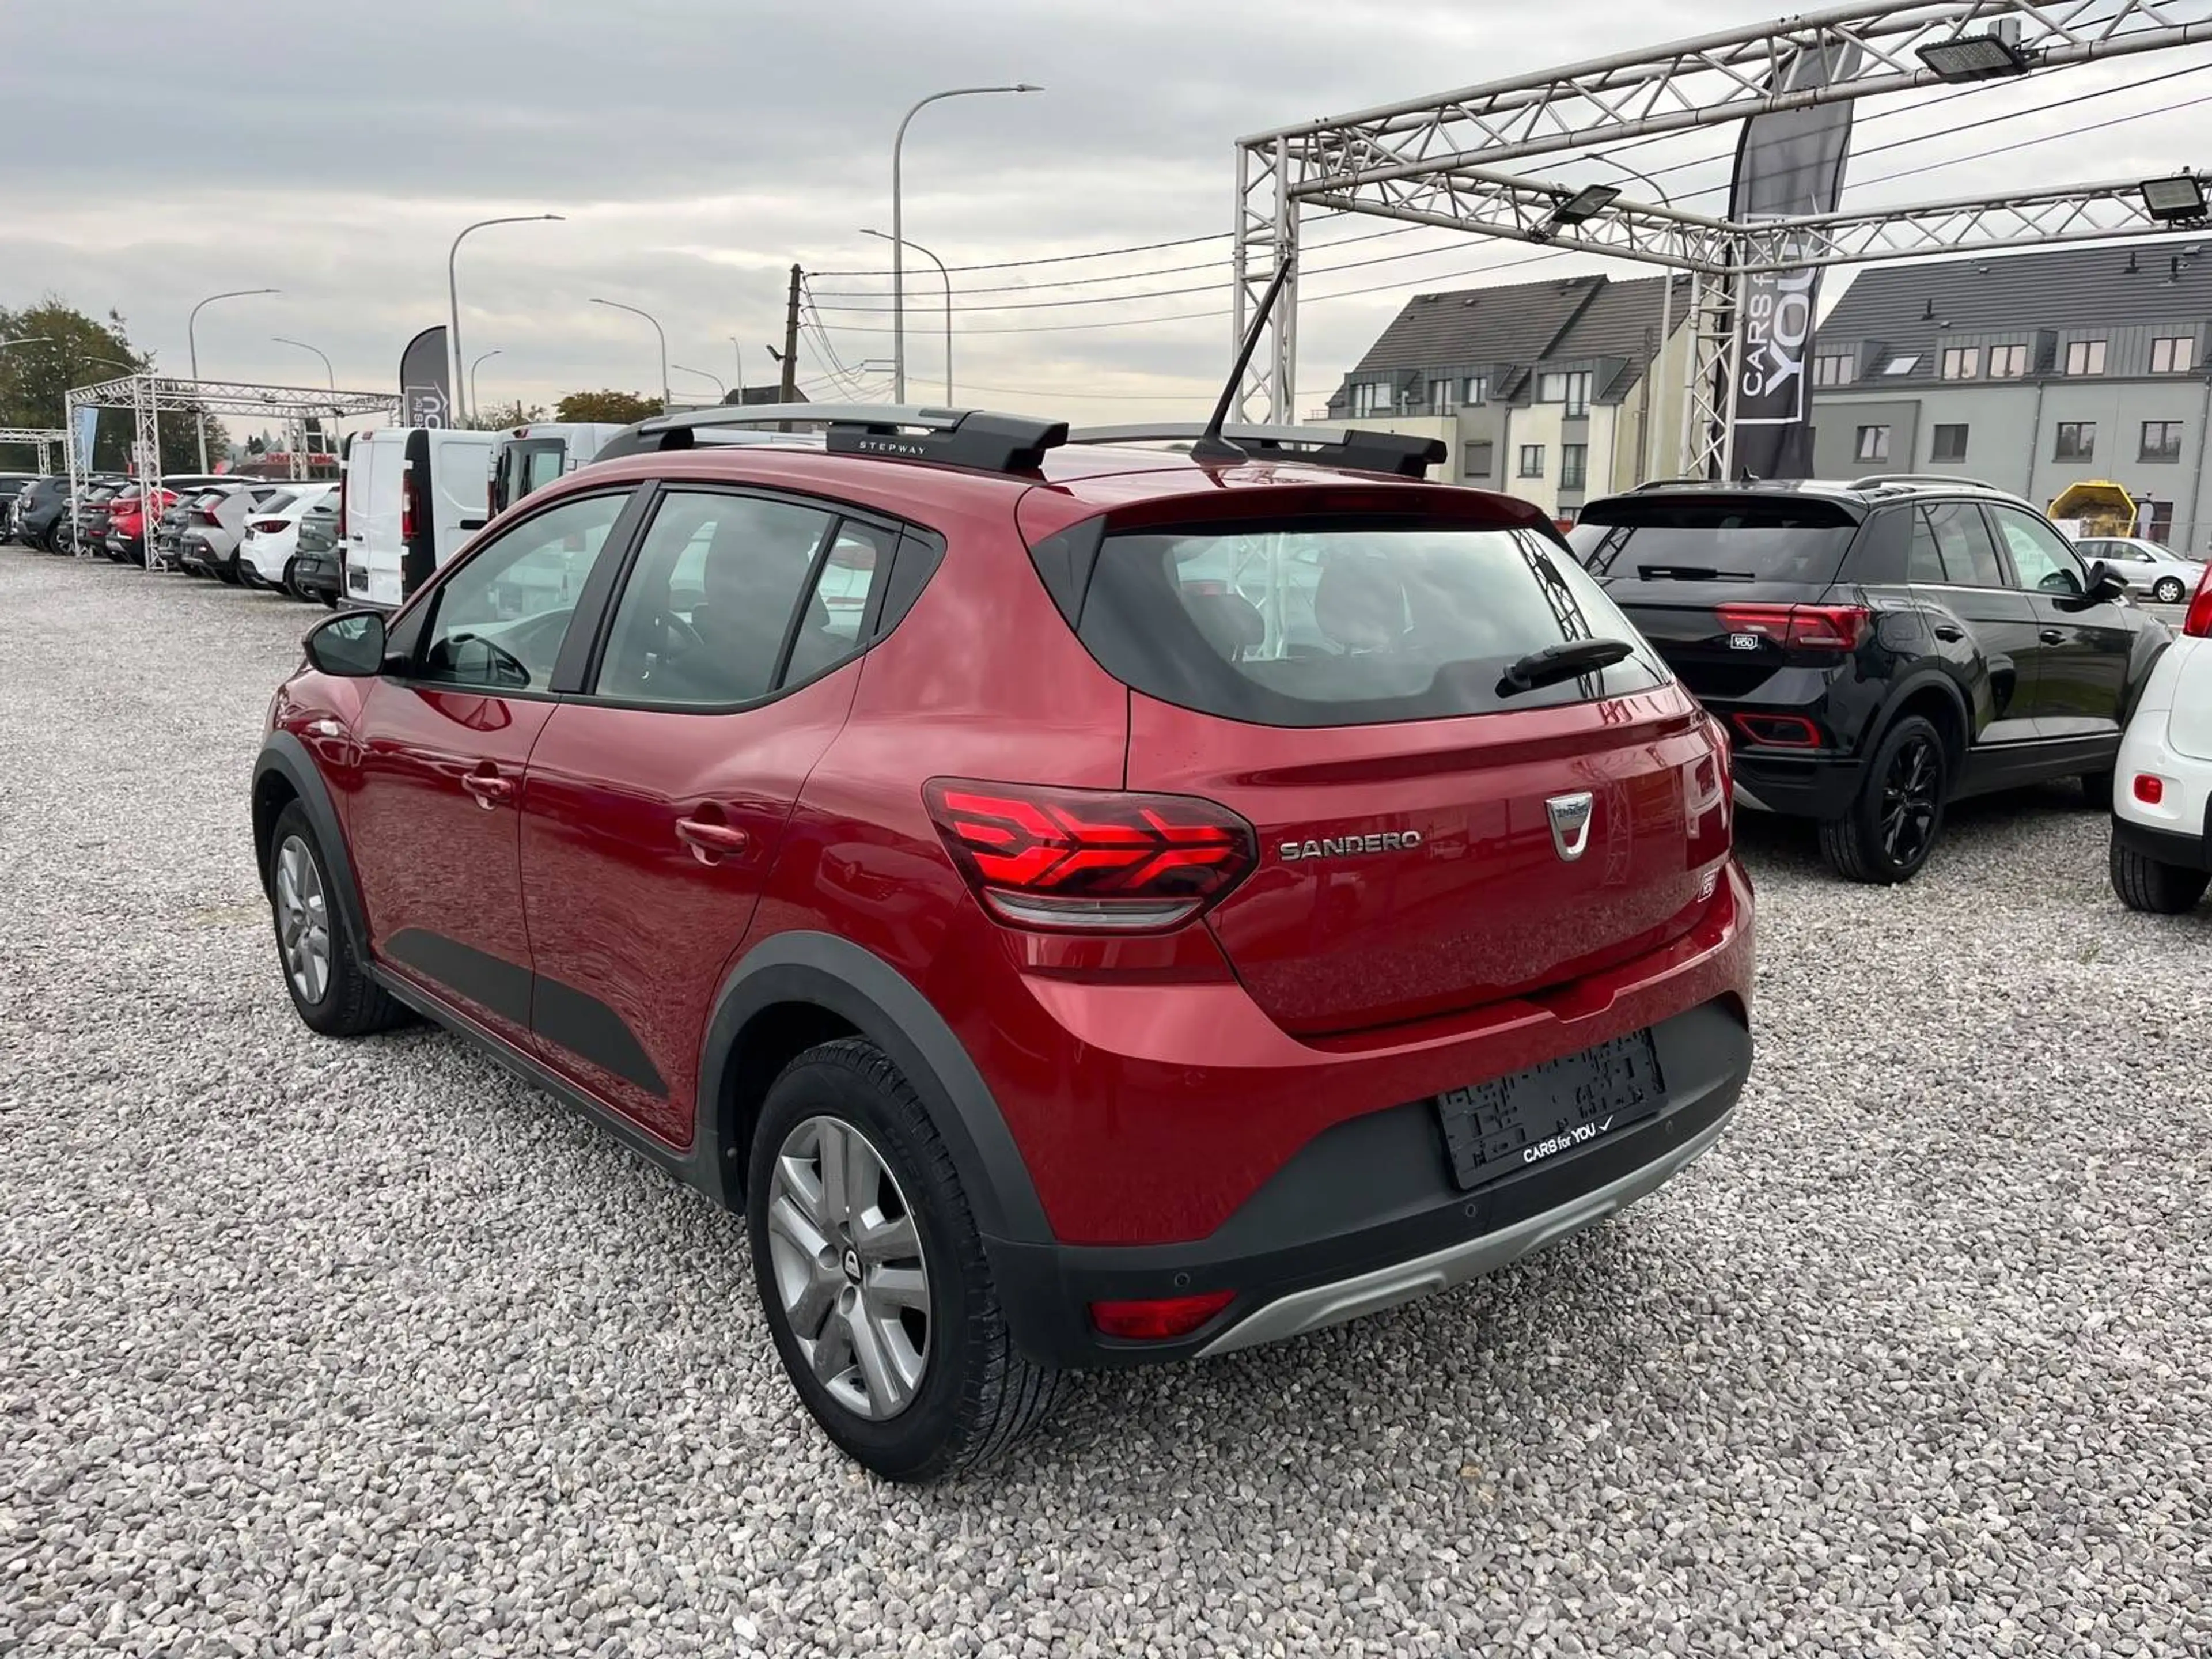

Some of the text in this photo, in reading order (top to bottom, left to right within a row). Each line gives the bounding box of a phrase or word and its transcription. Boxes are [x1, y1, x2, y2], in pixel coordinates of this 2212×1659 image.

[1765, 243, 1816, 397] YOU
[1743, 294, 1772, 397] CARS
[423, 396, 441, 429] OU
[860, 441, 926, 454] STEPWAY
[1280, 830, 1422, 861] SANDERO
[1558, 1135, 1571, 1150] for
[1571, 1122, 1596, 1143] YOU
